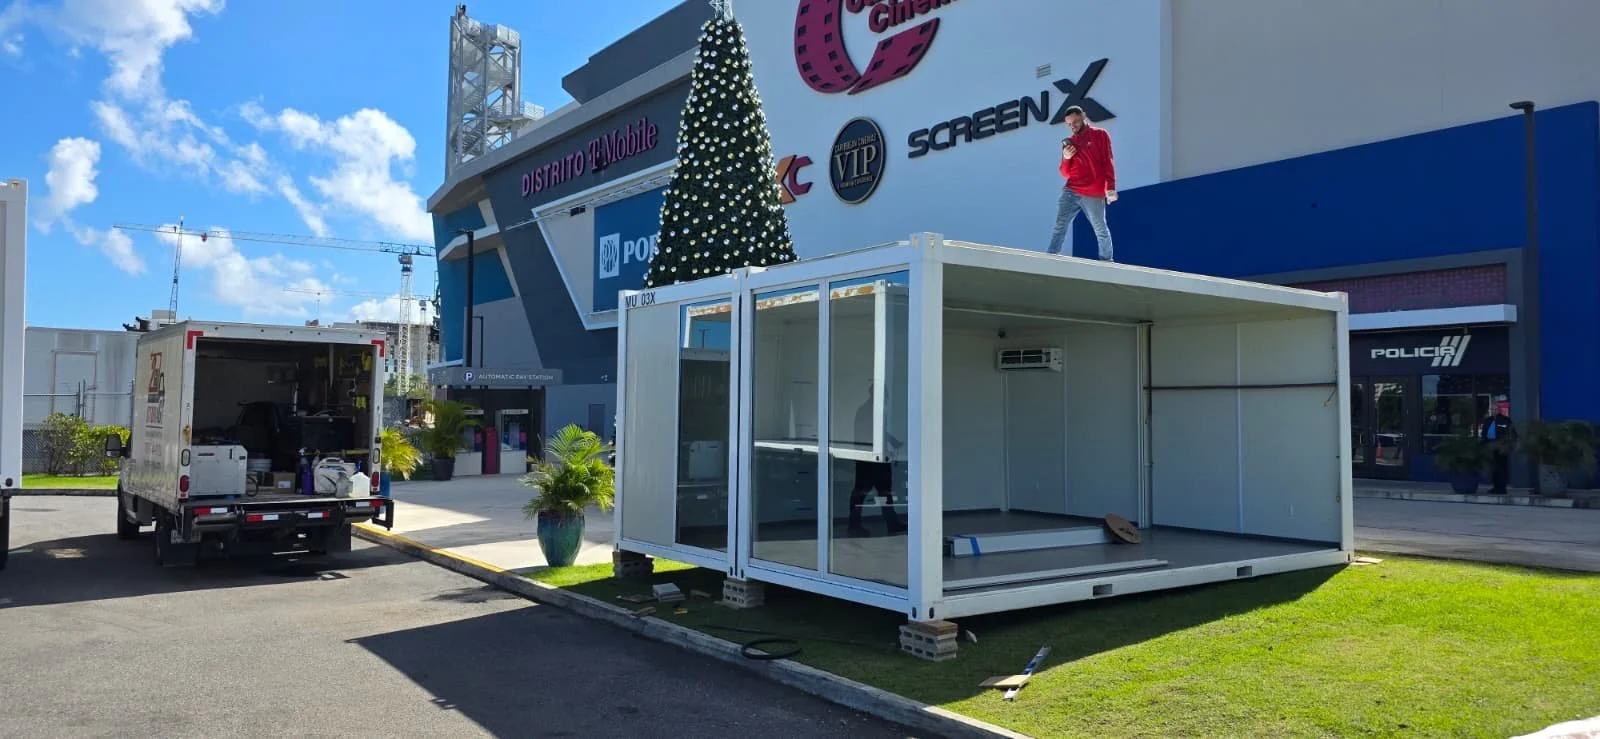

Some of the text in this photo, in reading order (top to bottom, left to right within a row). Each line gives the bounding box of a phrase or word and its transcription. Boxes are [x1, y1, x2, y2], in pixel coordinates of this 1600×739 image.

[522, 151, 584, 197] DISTRITO
[833, 145, 876, 180] VIP
[641, 291, 656, 306] 03X
[1371, 346, 1455, 359] POLICIA
